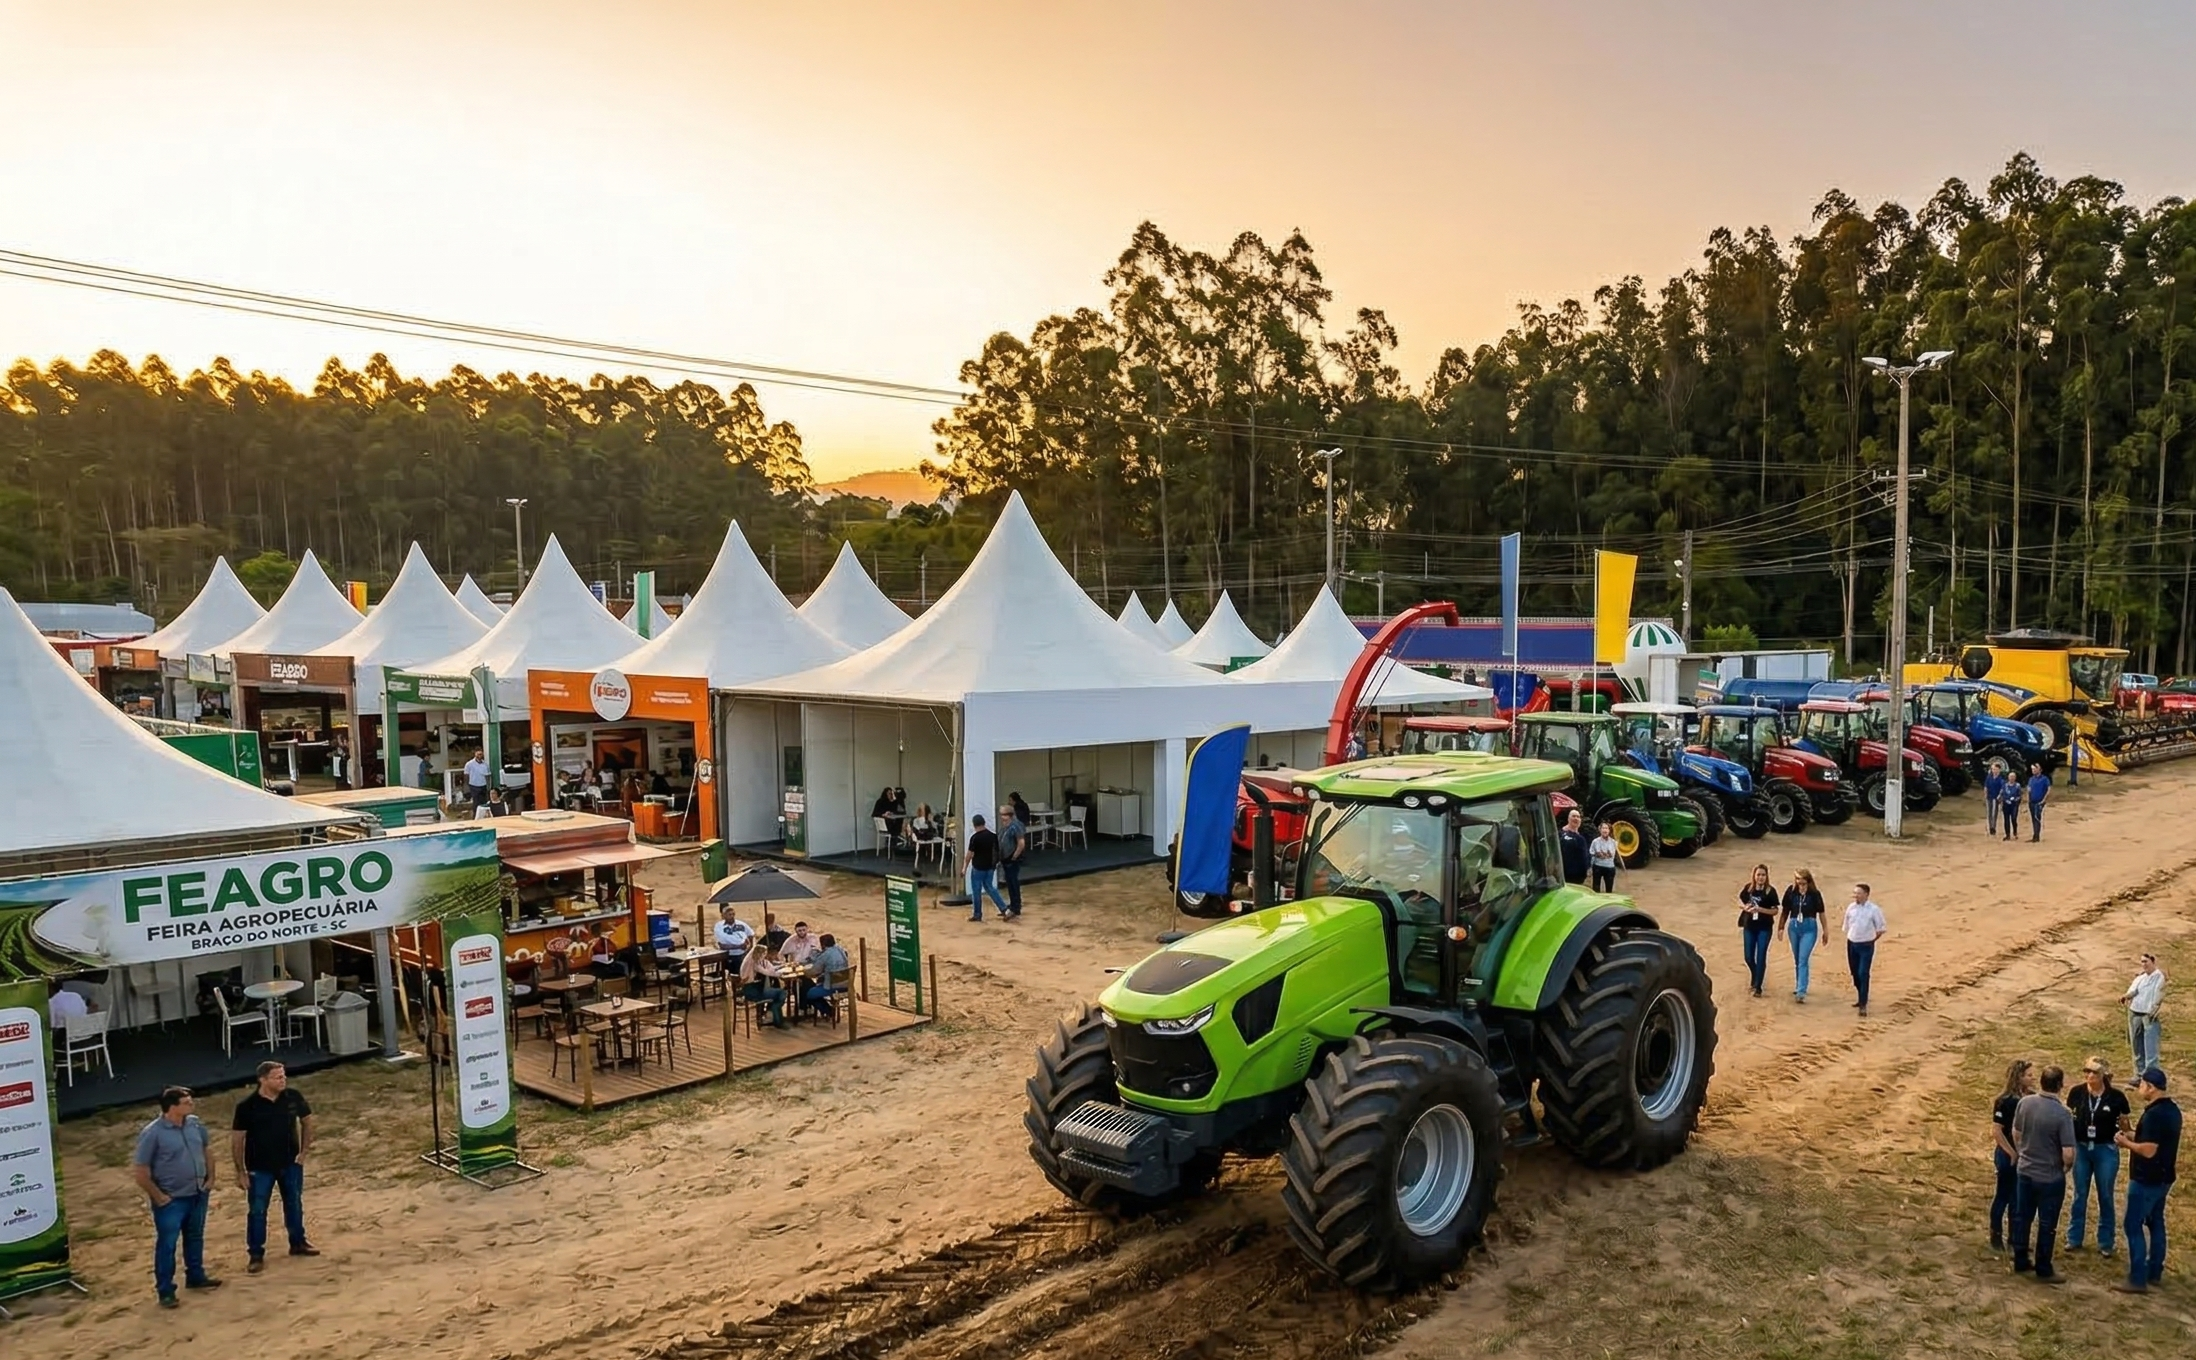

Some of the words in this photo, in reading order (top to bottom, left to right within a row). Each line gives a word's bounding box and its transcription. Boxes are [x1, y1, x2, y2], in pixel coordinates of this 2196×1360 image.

[122, 850, 394, 924] FEAGRO
[147, 921, 213, 942] FEIRA
[219, 898, 378, 933] AGROPECUÁRIA
[191, 934, 243, 950] BRAÇO
[247, 930, 268, 942] DO
[271, 923, 319, 939] NORTE
[330, 919, 348, 931] SC
